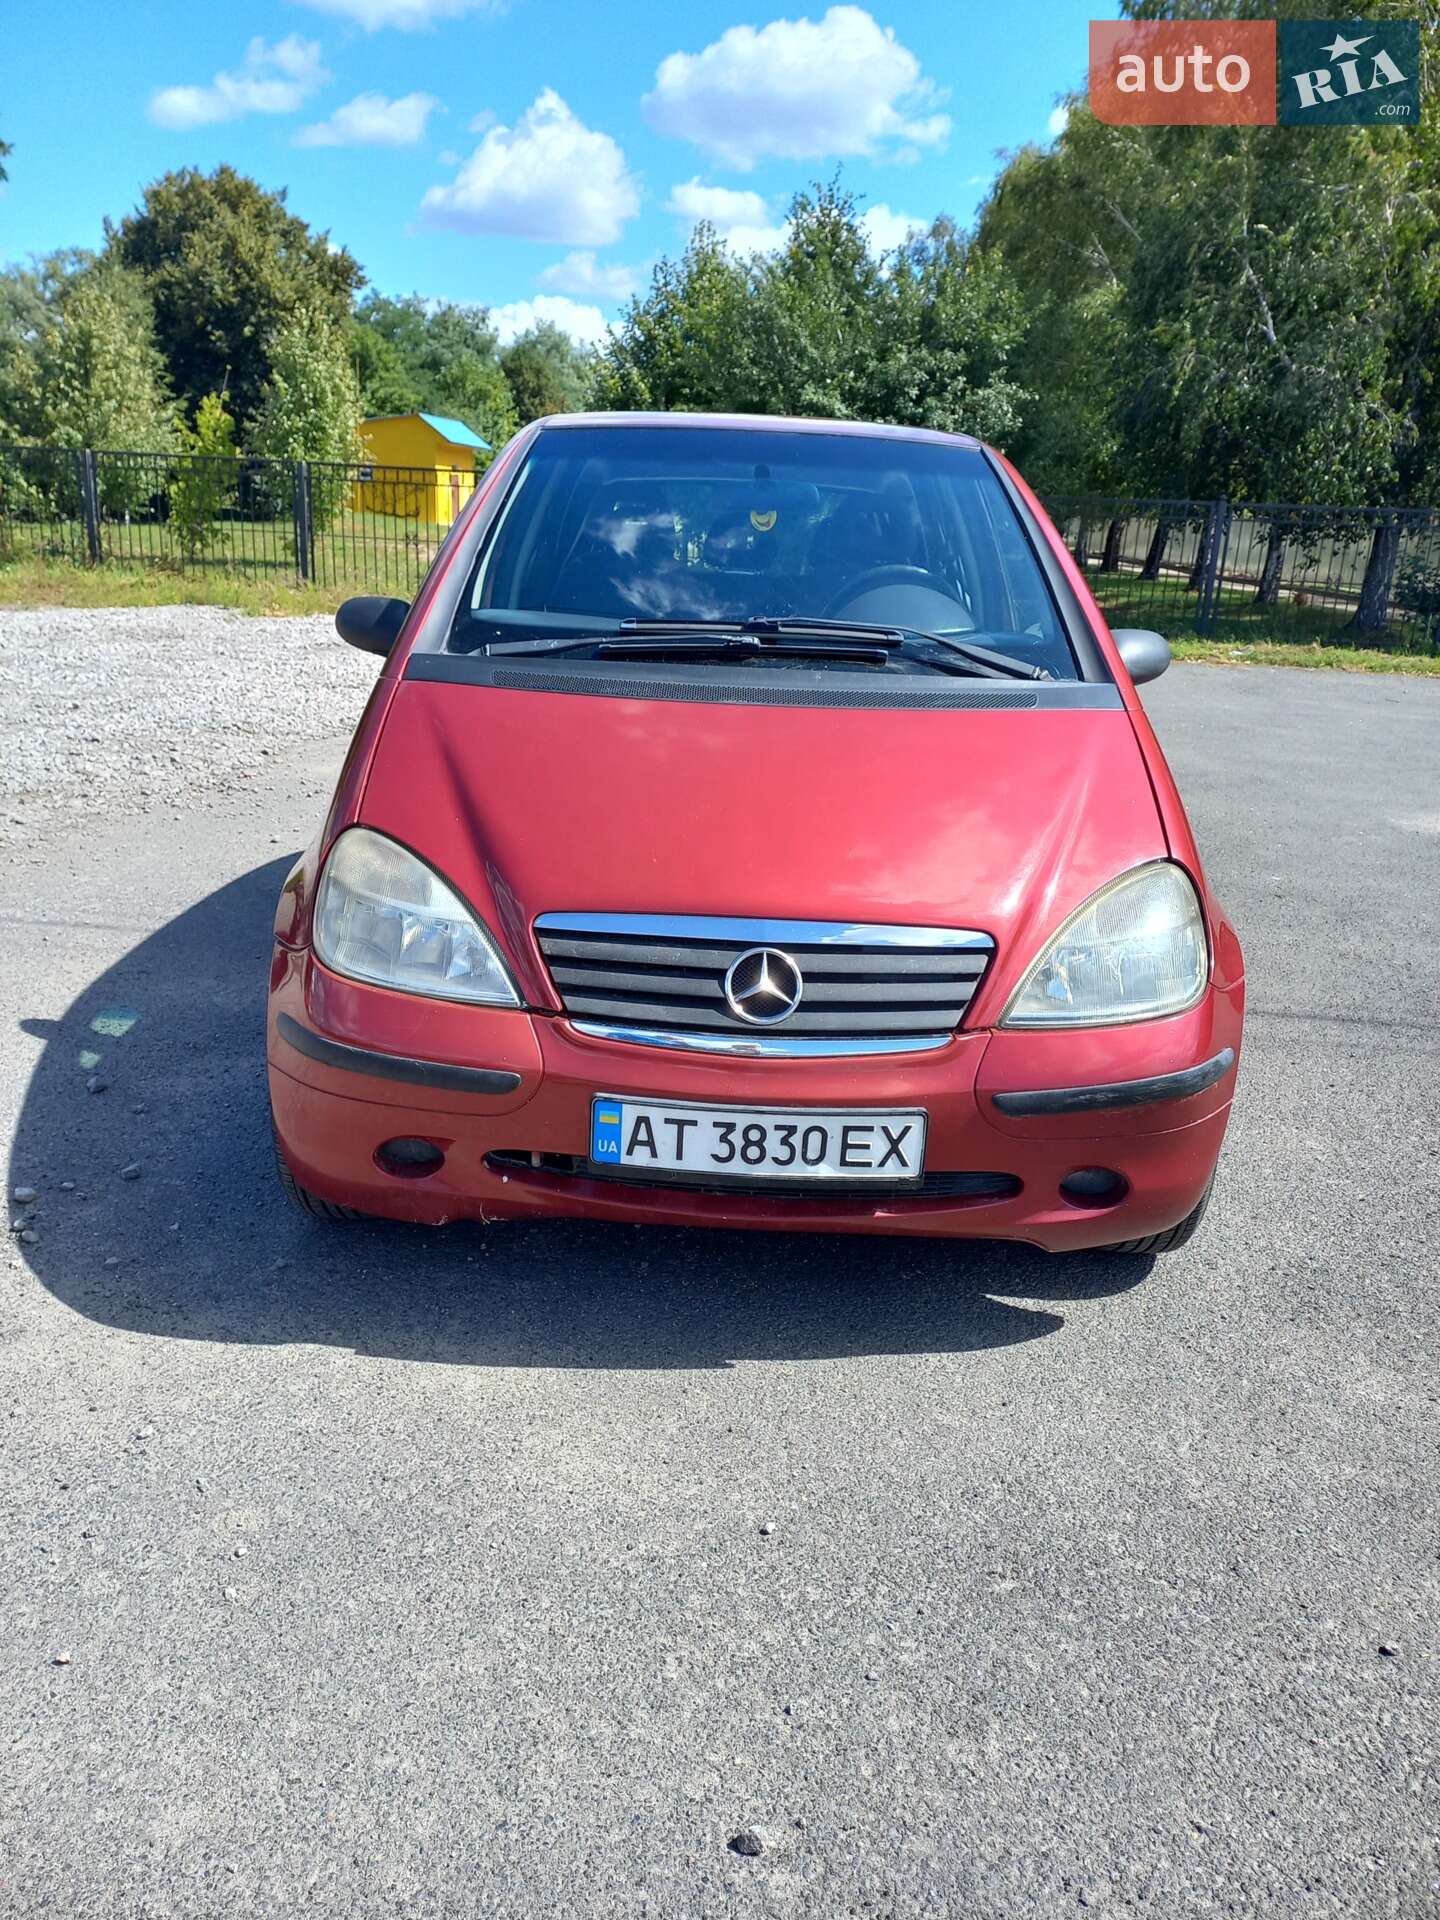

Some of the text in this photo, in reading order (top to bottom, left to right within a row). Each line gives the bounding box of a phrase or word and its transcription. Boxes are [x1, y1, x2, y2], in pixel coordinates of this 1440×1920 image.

[598, 1139, 618, 1154] UA
[625, 1116, 915, 1168] AT 3830 EX
